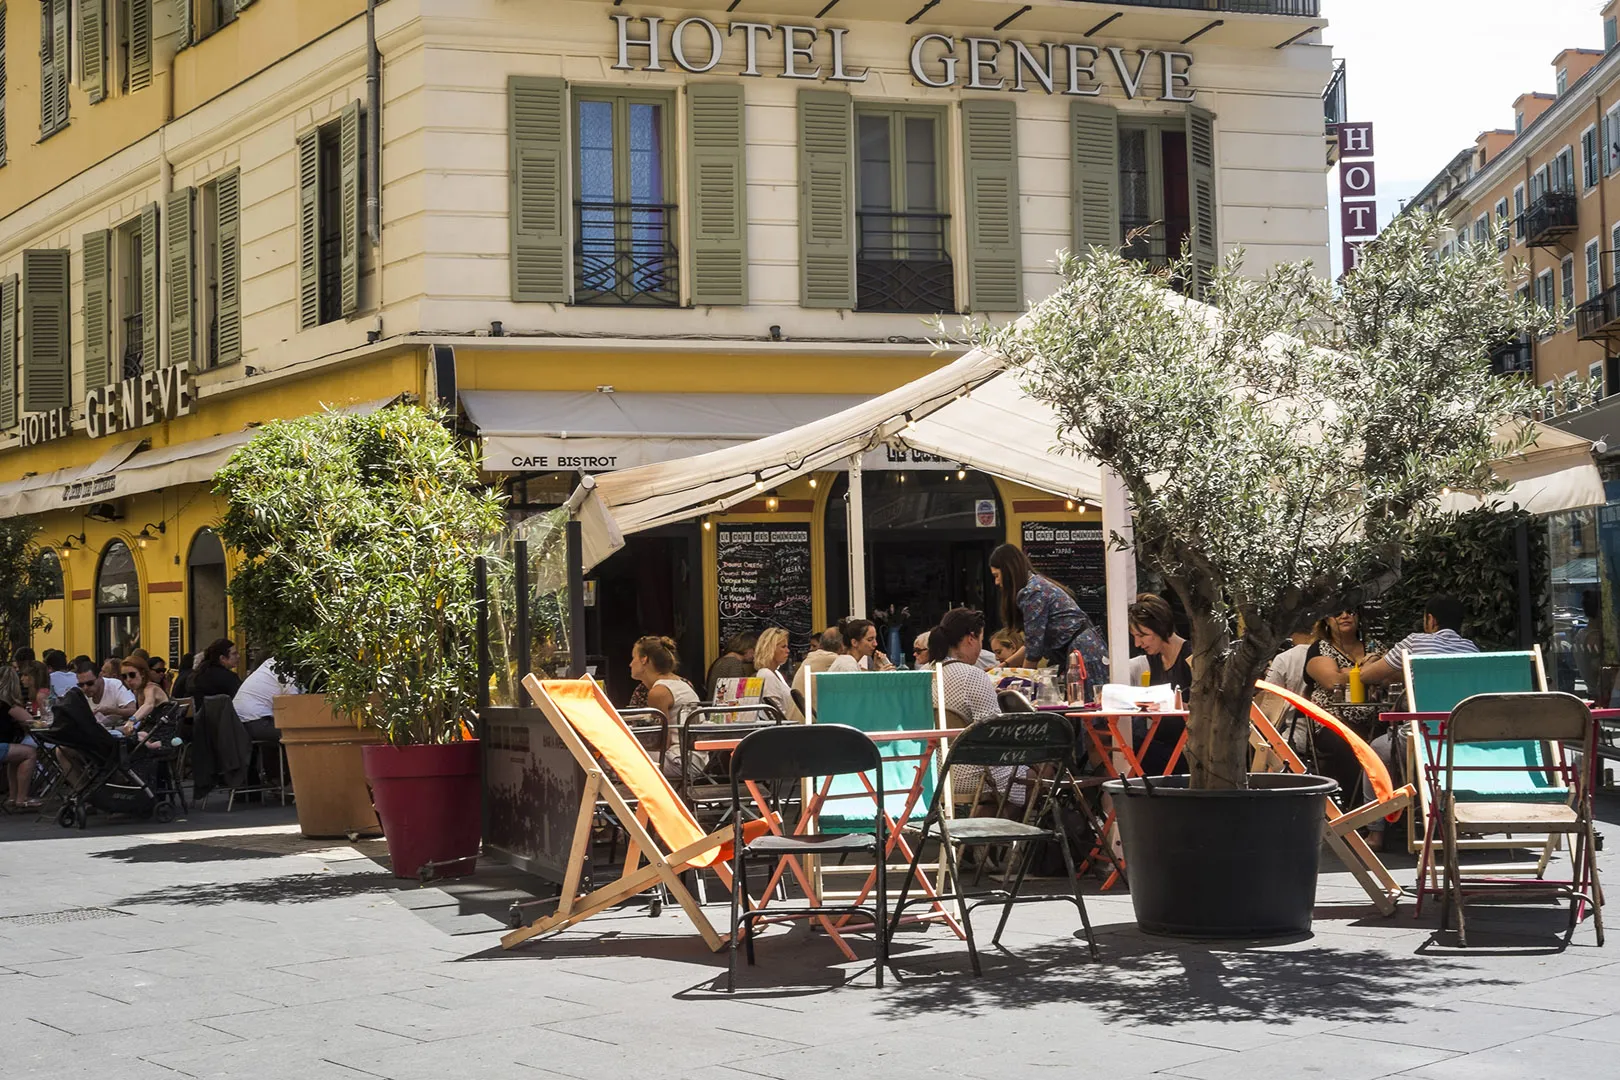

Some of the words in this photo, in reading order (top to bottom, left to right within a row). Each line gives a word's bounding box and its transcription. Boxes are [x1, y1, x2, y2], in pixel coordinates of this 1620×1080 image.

[610, 14, 869, 82] HOTEL
[909, 33, 1197, 102] GENEVE
[18, 407, 67, 447] HOTEL
[85, 361, 191, 439] GENEVE
[511, 456, 548, 467] CAFE
[557, 456, 618, 467] BISTROT
[720, 531, 730, 542] LE
[754, 531, 769, 542] DES
[1024, 530, 1034, 541] LE
[1055, 530, 1070, 541] DES
